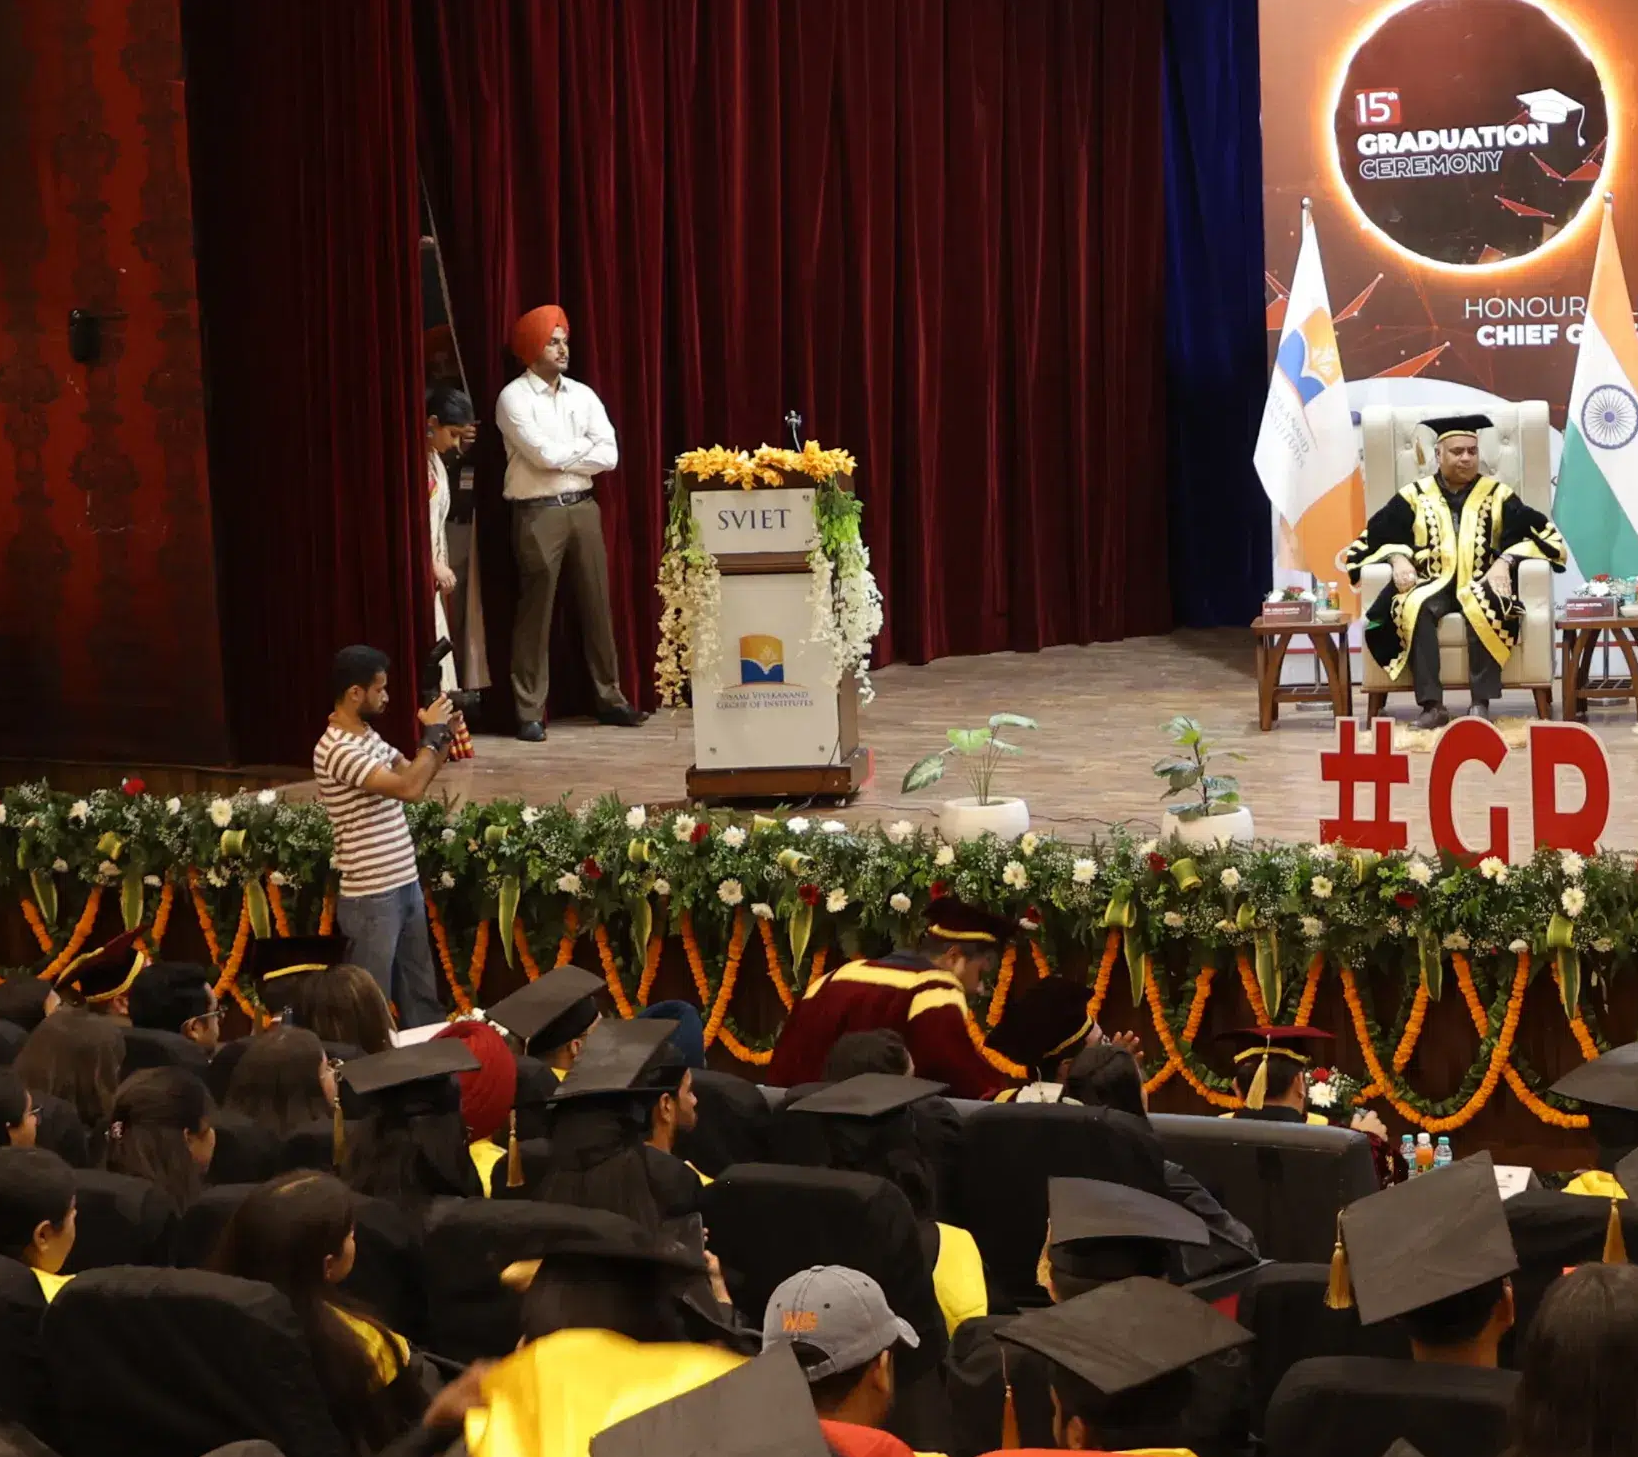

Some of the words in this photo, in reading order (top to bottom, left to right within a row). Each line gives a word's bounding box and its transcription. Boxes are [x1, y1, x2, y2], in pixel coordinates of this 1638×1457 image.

[1355, 91, 1399, 123] 15th
[1357, 123, 1549, 155] GRADUATION
[1359, 150, 1503, 179] CEREMONY
[1476, 324, 1559, 347] CHIEF
[717, 508, 791, 531] SVIET
[749, 701, 760, 709] OF
[763, 699, 814, 708] INSTITUTES
